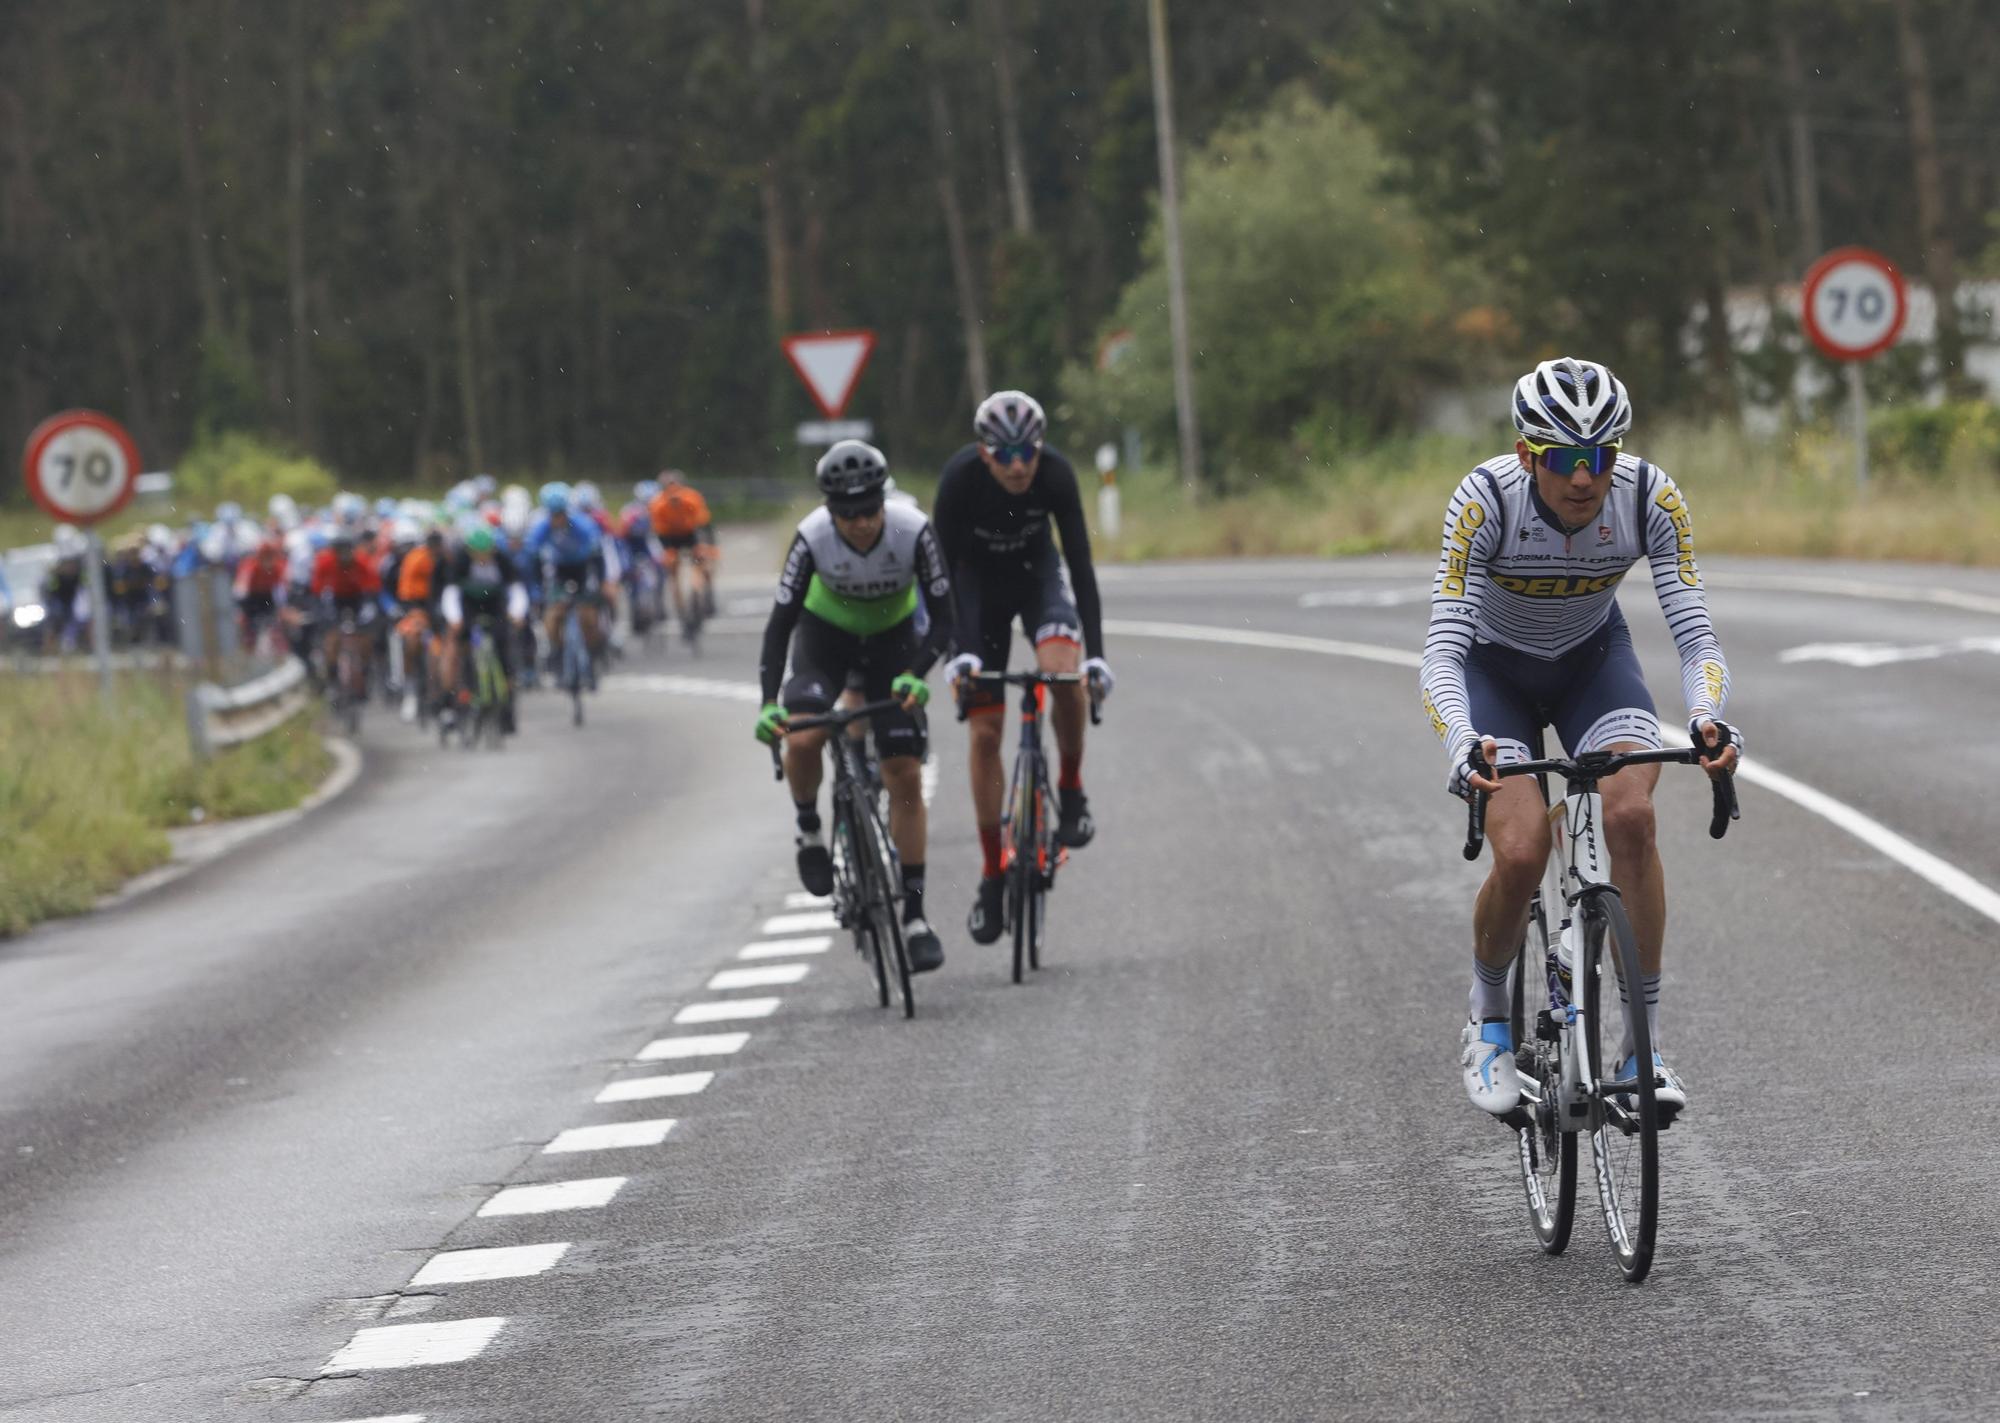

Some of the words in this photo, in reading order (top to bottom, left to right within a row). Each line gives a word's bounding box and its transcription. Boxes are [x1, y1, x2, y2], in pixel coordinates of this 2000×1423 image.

[1827, 286, 1885, 322] 70
[53, 449, 113, 488] 70
[1440, 500, 1485, 598] DELKO
[1511, 554, 1551, 562] CORIMA
[1579, 555, 1627, 564] LOOK
